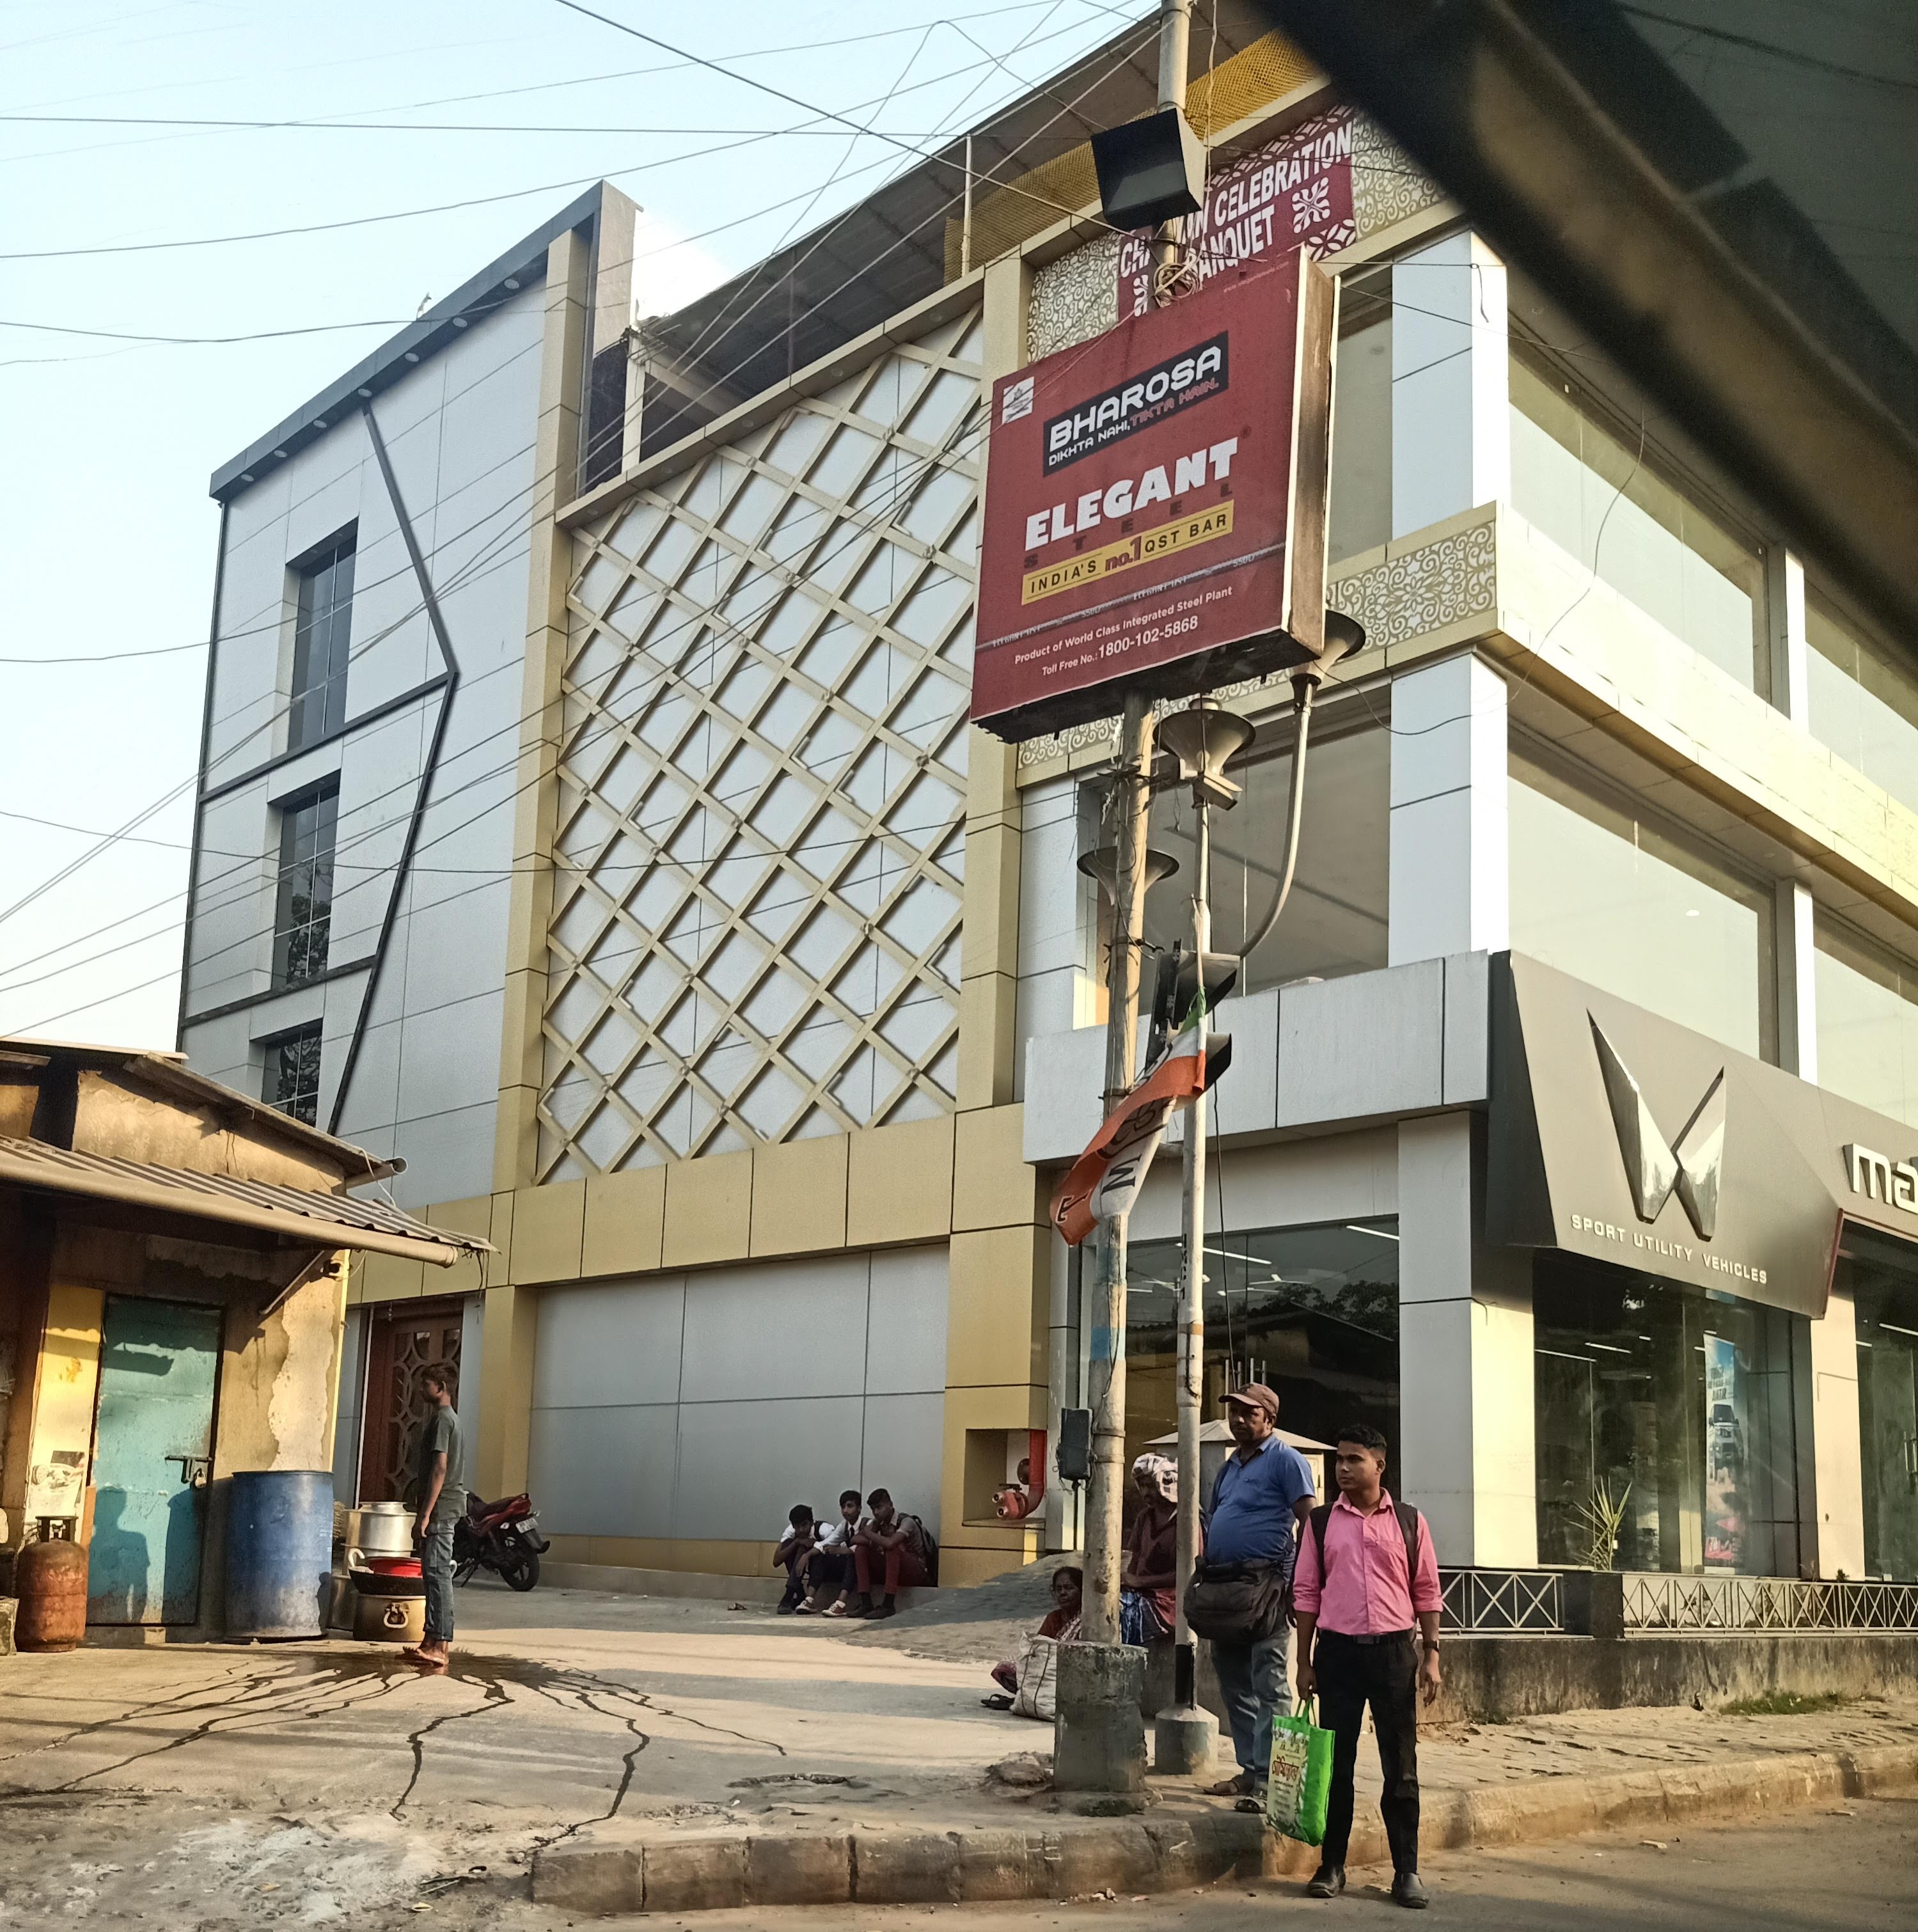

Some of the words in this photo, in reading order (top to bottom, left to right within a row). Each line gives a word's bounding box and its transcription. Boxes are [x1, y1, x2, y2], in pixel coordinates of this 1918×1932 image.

[1215, 121, 1352, 227] CELEBRATION
[1048, 437, 1094, 466] DIKHTA
[1098, 420, 1131, 443] NAHI,
[1130, 397, 1174, 427] TIKTA
[1049, 346, 1222, 452] BHAROSA
[1025, 436, 1238, 551] ELEGANT
[1031, 560, 1096, 593] INDIA'S
[1145, 530, 1179, 553] QST
[1190, 514, 1226, 538] BAR
[1014, 647, 1050, 664] Product
[1052, 641, 1063, 652] of
[1064, 633, 1094, 648] World
[1096, 624, 1120, 639] Class
[1123, 604, 1174, 630] Integrated
[1177, 595, 1203, 612] Steel
[1206, 586, 1232, 602] Plant
[1042, 664, 1057, 676] Toll
[1059, 659, 1078, 671] Free
[1098, 615, 1199, 659] 1800-102-5868
[1571, 1214, 1626, 1243] SPORT
[1633, 1232, 1693, 1262] UTILITY
[1702, 1253, 1767, 1285] VEHICLES
